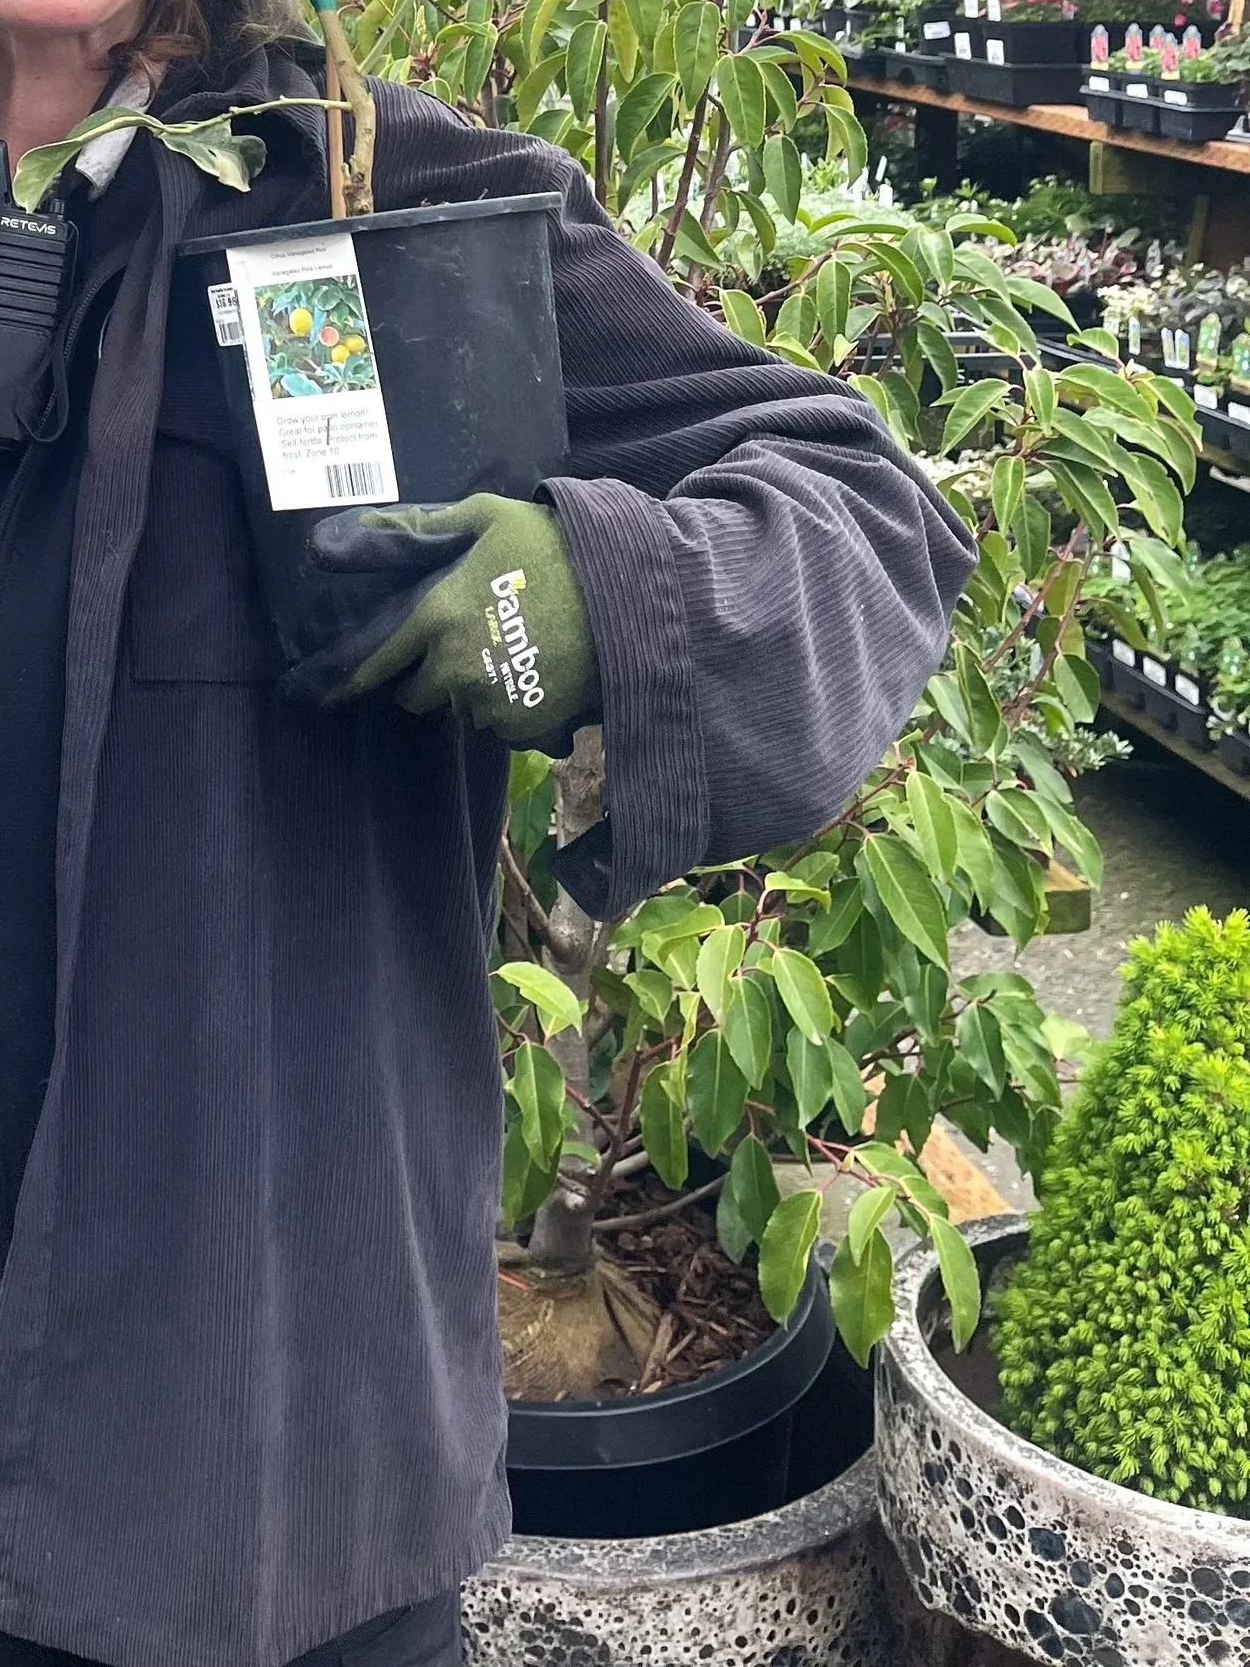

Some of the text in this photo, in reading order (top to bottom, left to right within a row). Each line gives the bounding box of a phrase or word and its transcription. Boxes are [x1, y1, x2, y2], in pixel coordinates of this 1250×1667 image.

[0, 216, 57, 235] RETEVIS
[276, 416, 299, 426] Grow
[301, 414, 319, 425] your
[279, 427, 302, 437] Great
[304, 426, 315, 435] for
[358, 432, 378, 441] from
[306, 448, 327, 458] Zone
[330, 446, 340, 455] 10
[490, 568, 545, 708] bamboo
[499, 661, 519, 704] NITRILE
